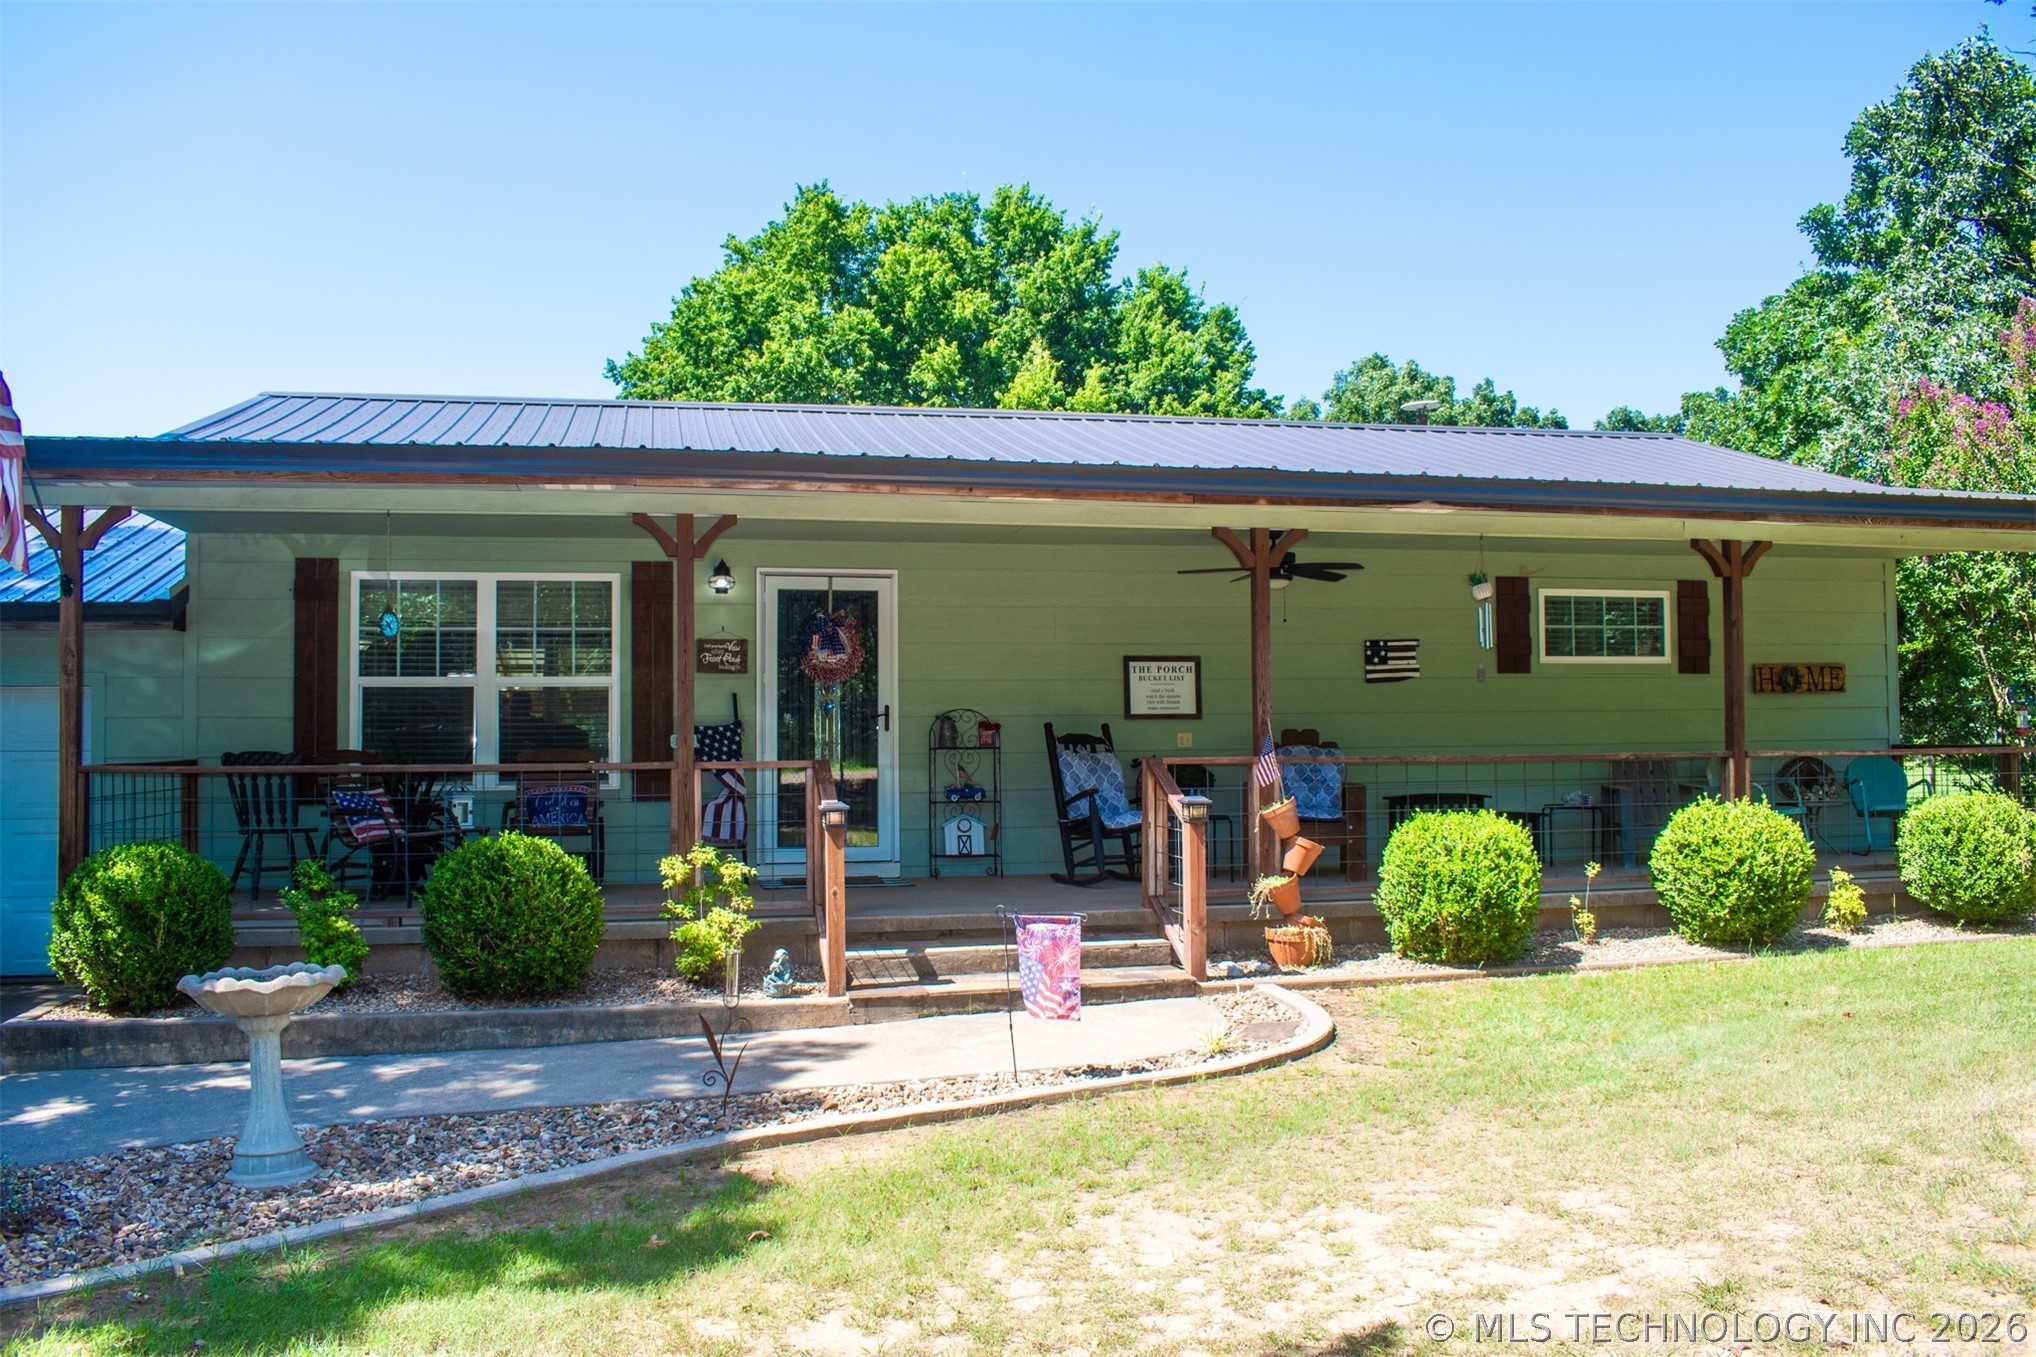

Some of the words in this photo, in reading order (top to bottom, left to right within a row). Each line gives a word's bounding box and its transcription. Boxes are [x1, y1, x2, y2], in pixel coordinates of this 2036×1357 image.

[1131, 665, 1152, 674] THE
[1157, 665, 1193, 674] PORCH
[532, 811, 586, 826] AMERICA
